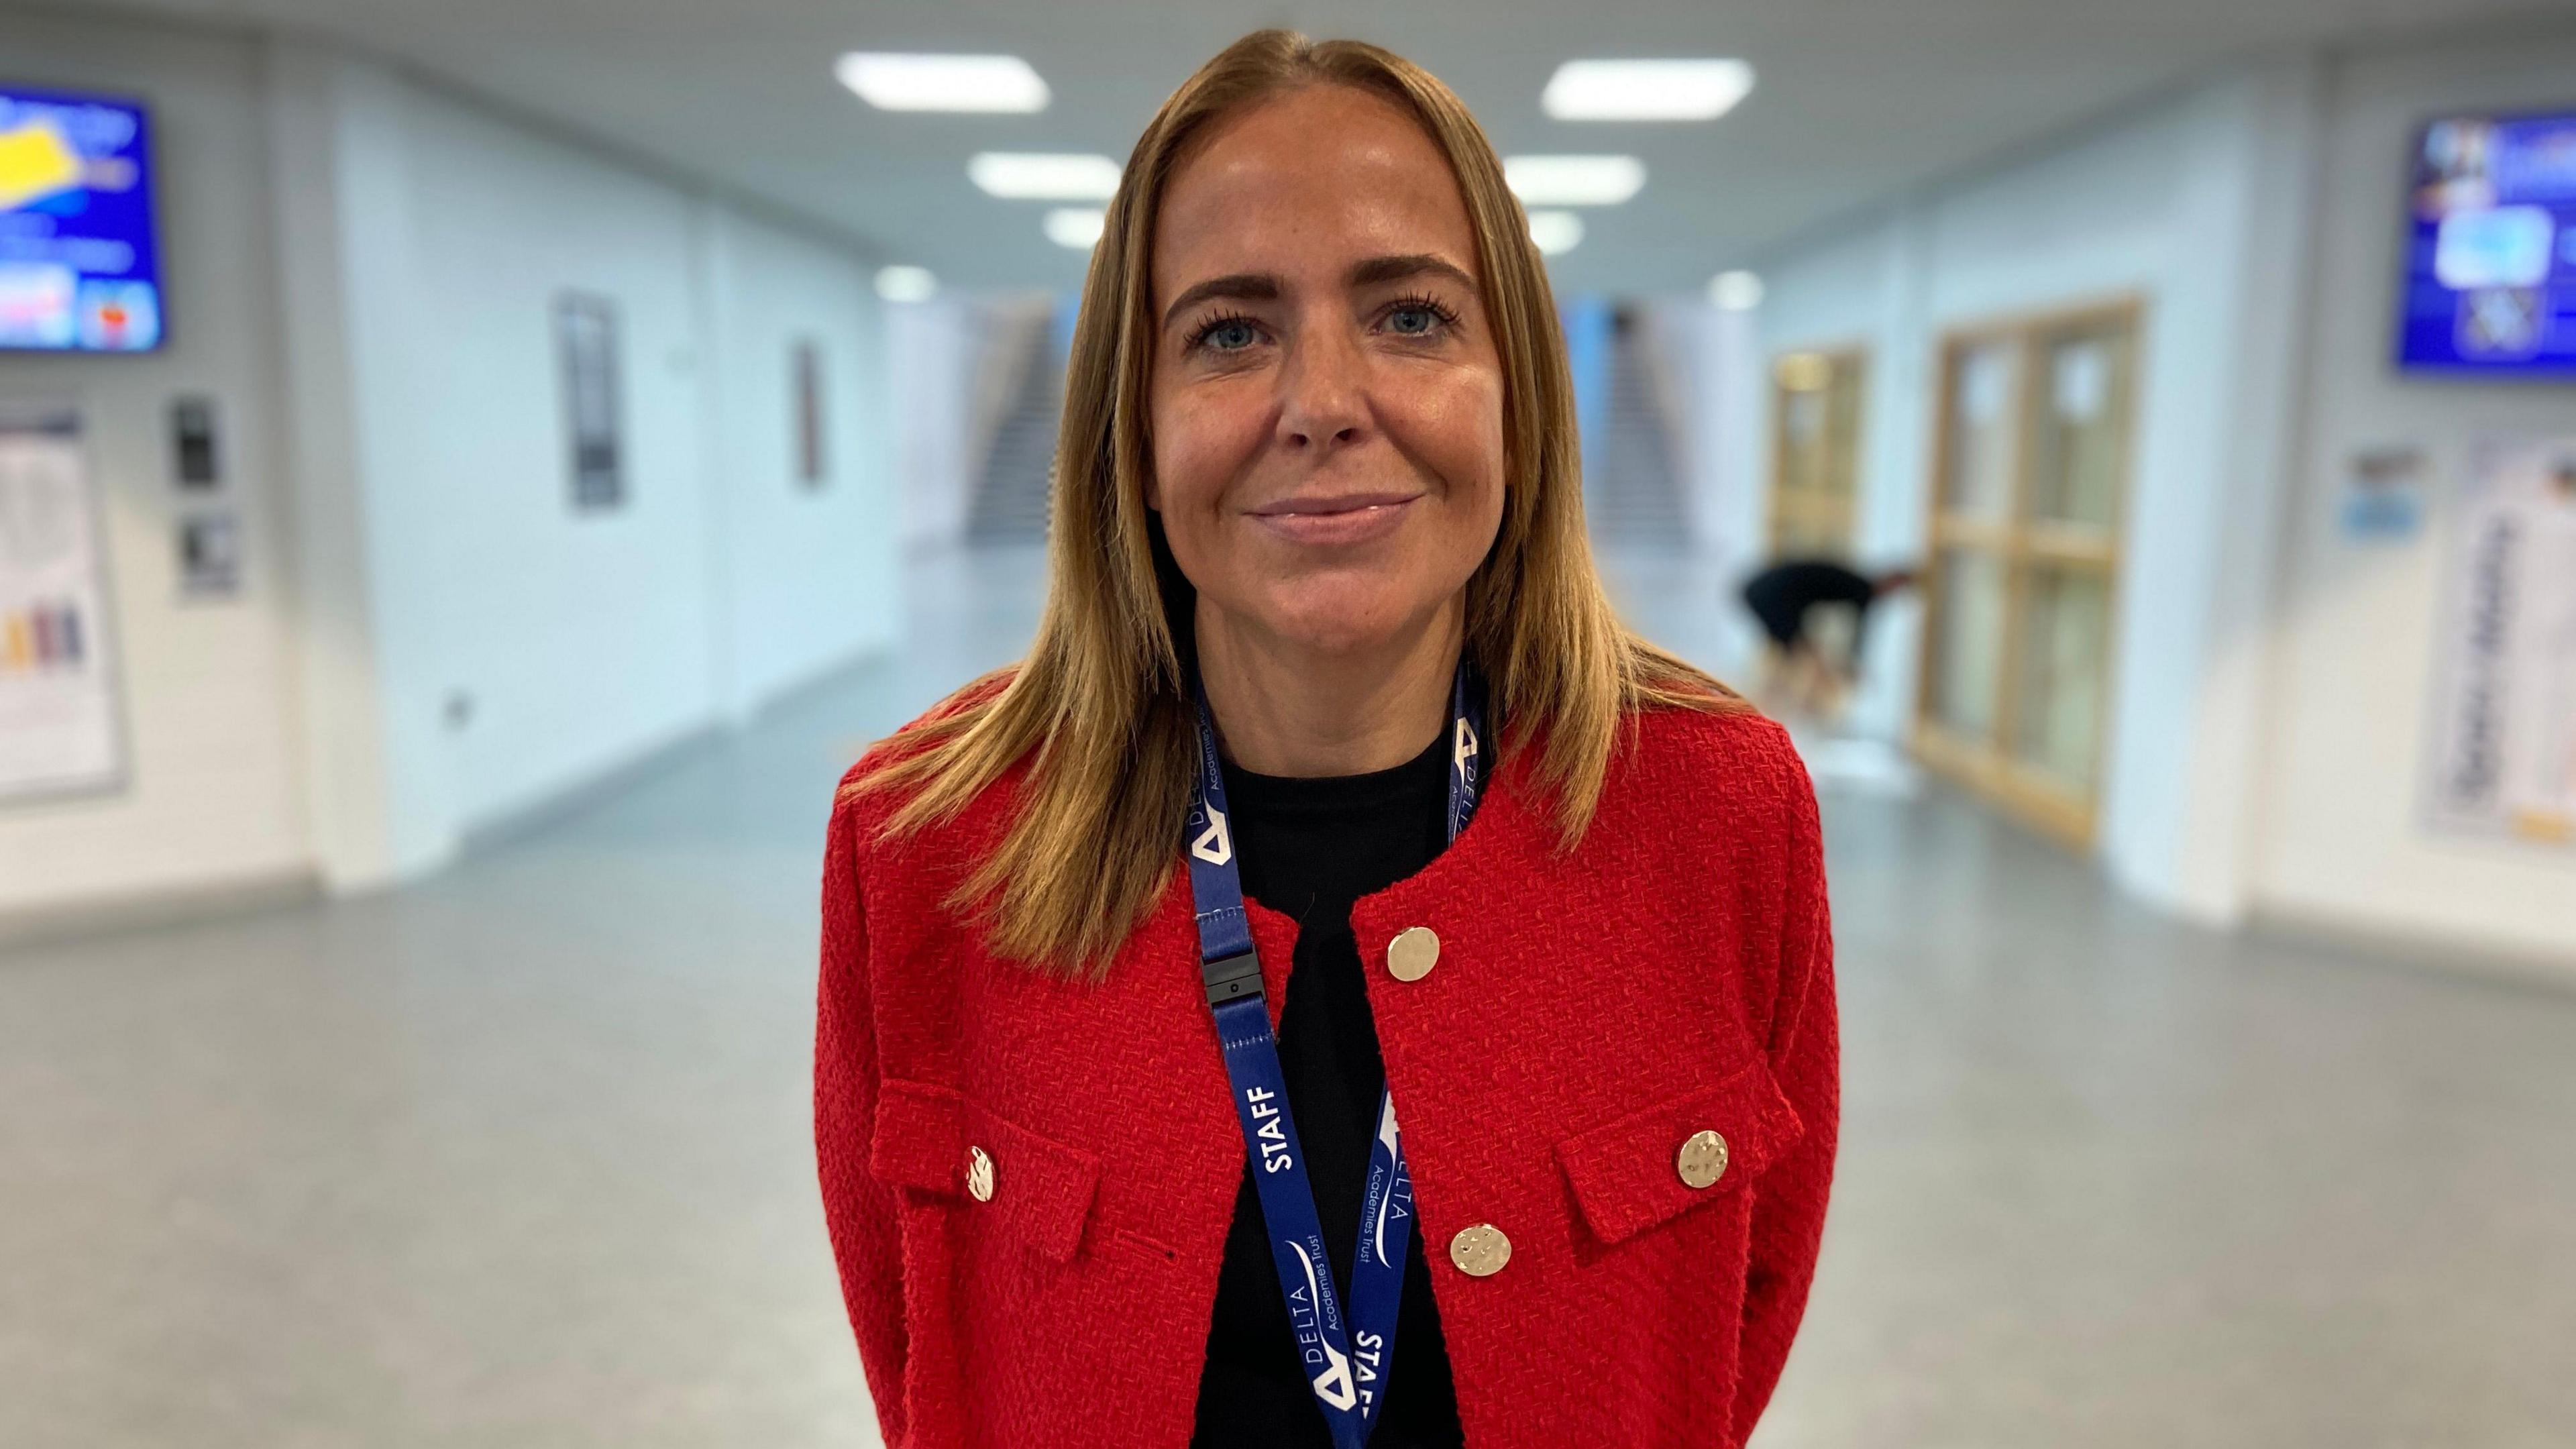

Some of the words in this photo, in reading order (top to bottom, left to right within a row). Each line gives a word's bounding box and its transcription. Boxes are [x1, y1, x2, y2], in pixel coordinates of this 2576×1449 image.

[1246, 1086, 1293, 1173] STAFF
[1364, 1165, 1385, 1234] Academies
[1307, 1234, 1322, 1261] Trust
[1359, 1236, 1374, 1264] Trust
[1290, 1286, 1324, 1364] DELTA
[1316, 1263, 1340, 1331] Academies
